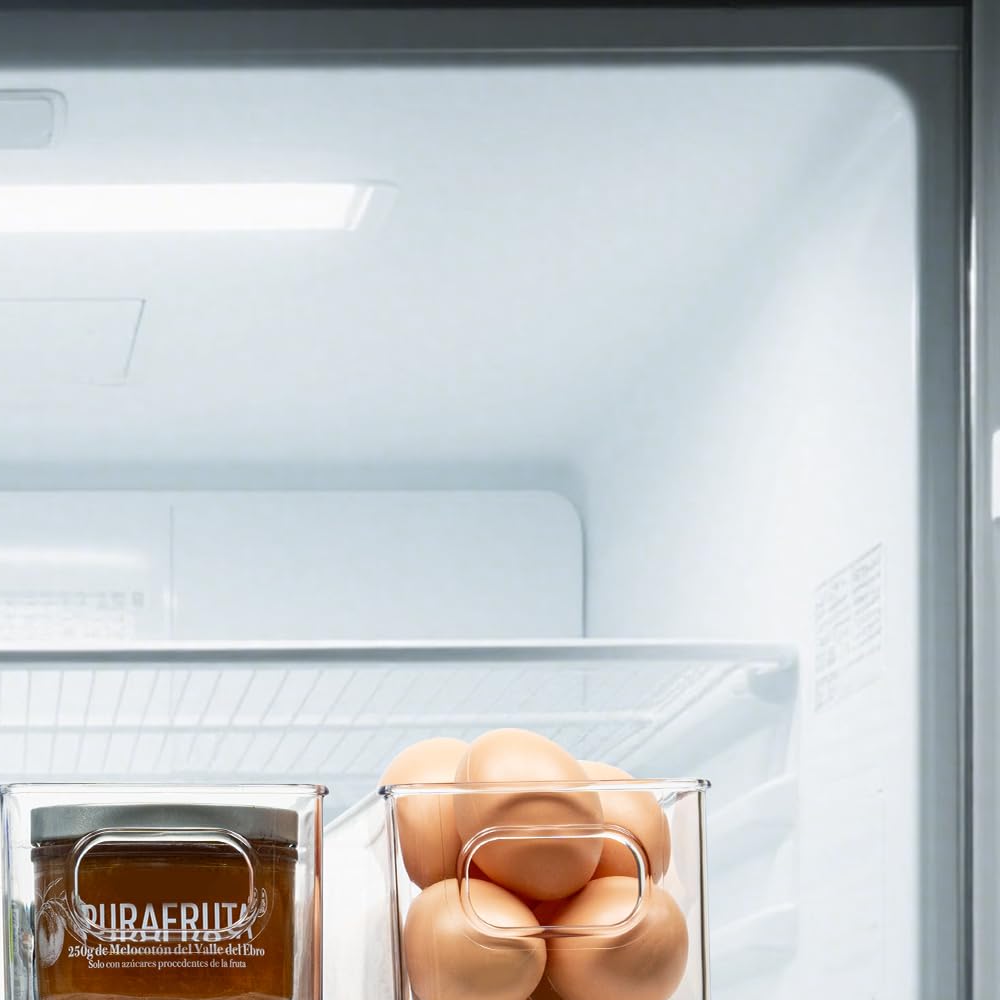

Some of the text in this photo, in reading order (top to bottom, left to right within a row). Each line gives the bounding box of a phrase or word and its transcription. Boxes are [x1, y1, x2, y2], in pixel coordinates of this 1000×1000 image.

[82, 902, 254, 943] PURAFRUTA
[68, 943, 265, 960] 250g de Melocotón del Valle del Ebro
[88, 959, 247, 970] Solo con azúcares procedentes de la fruta
